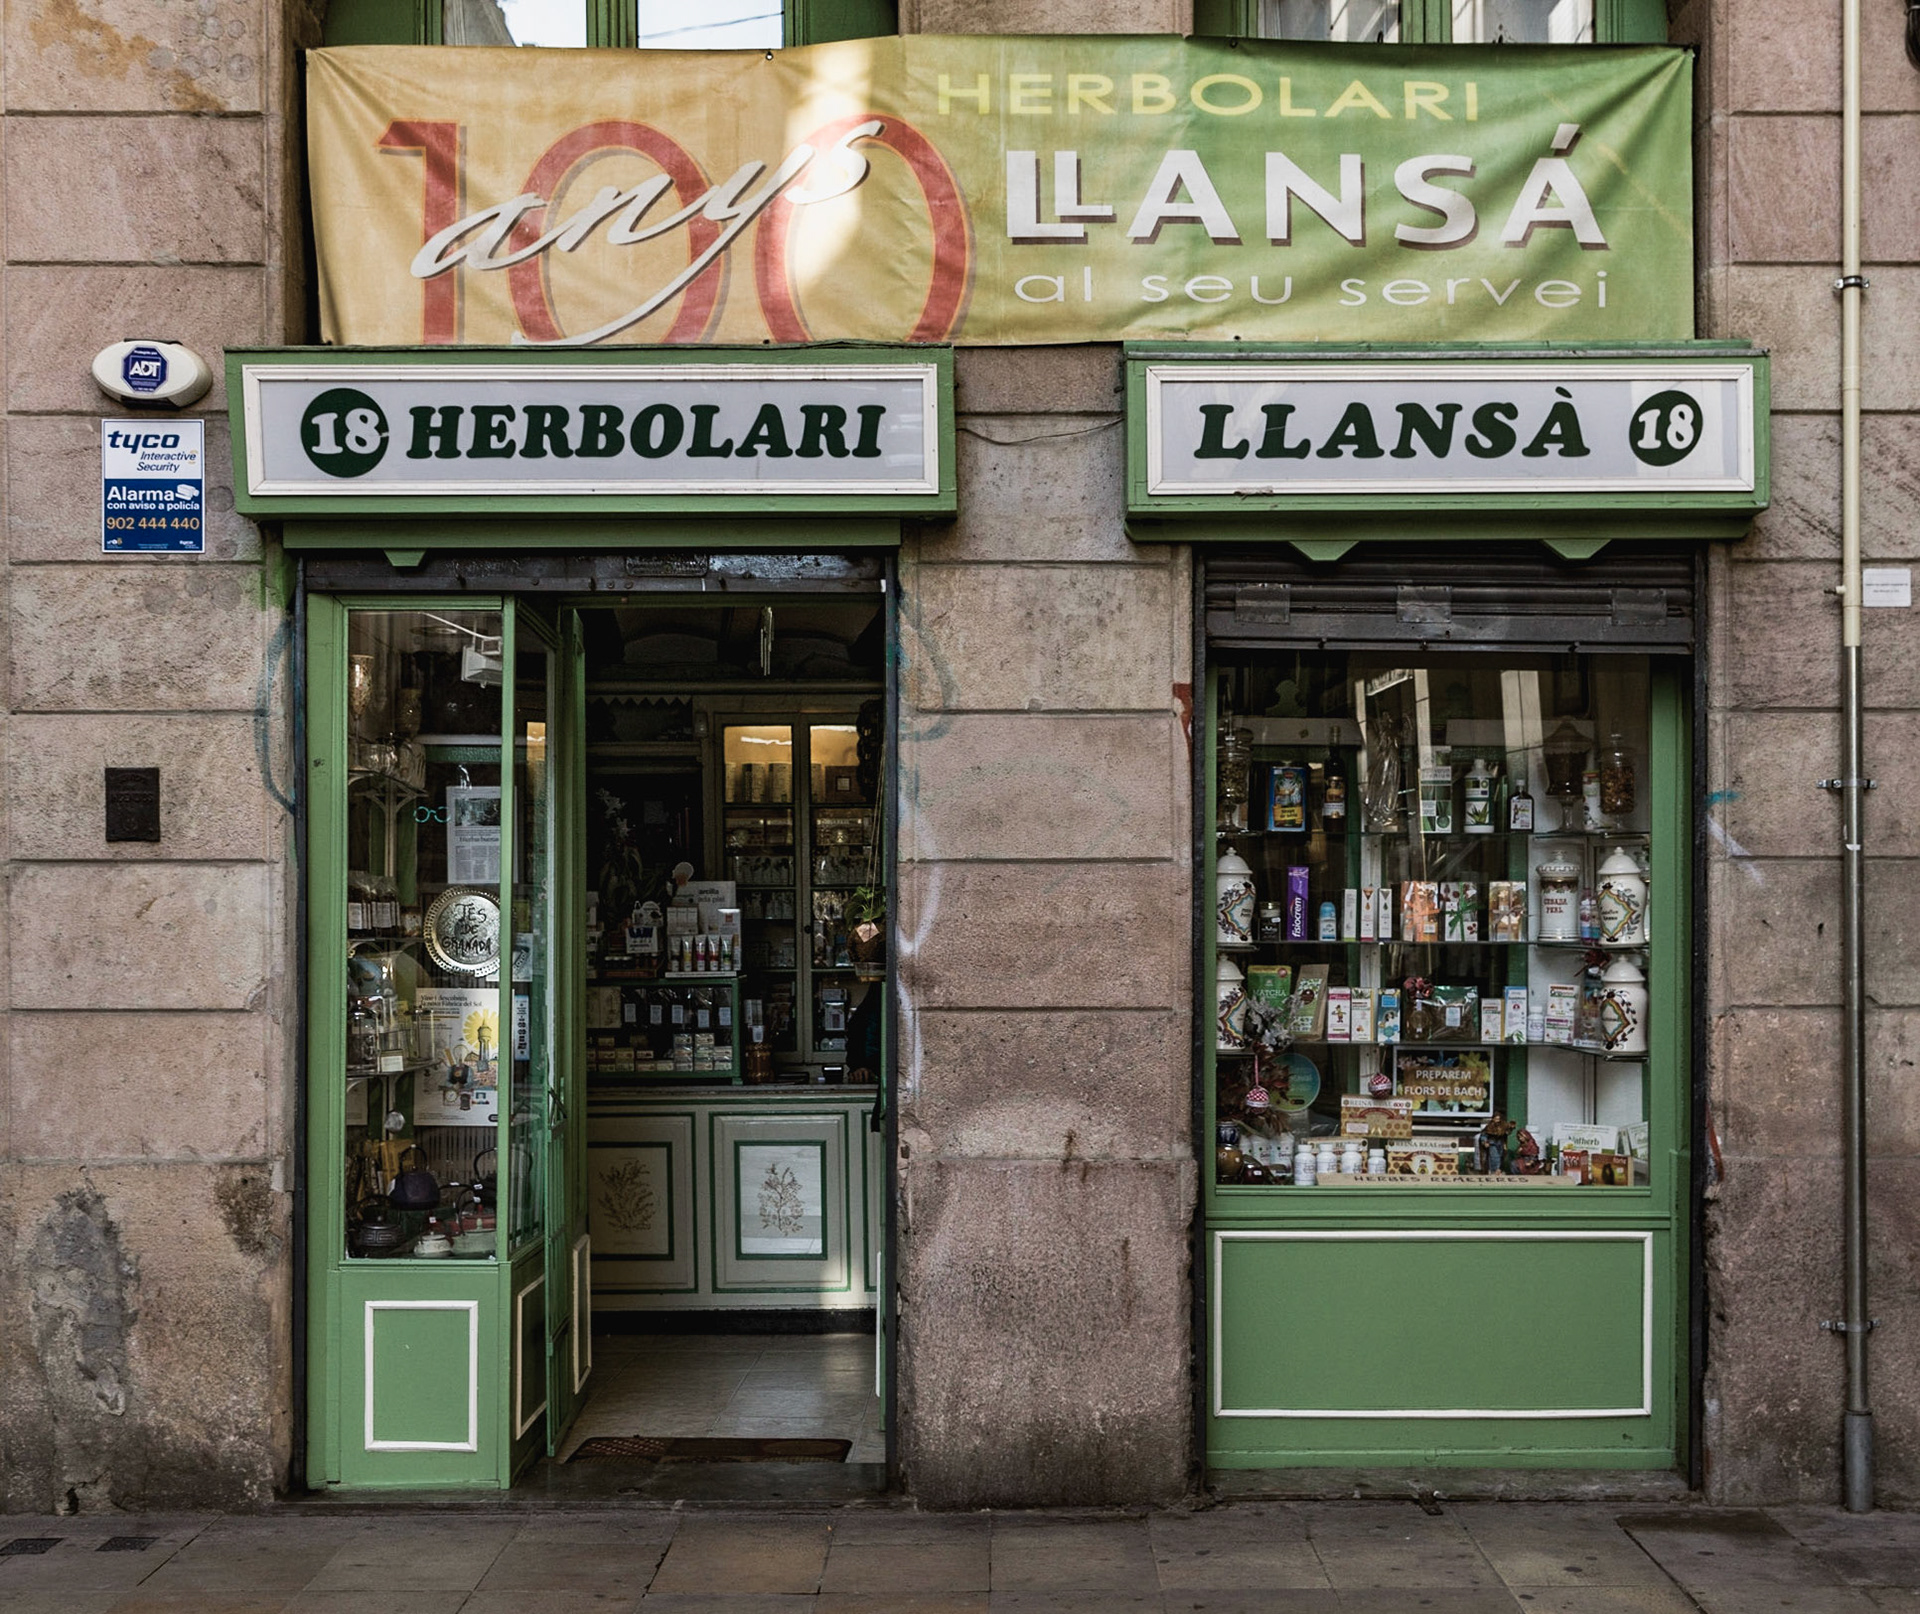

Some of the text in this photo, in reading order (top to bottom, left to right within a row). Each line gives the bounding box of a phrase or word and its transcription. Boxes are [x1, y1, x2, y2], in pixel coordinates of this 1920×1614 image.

[936, 73, 1478, 122] HERBOLARI
[1005, 123, 1610, 248] LLANSÁ
[373, 112, 974, 345] 100
[410, 119, 887, 345] anys
[1013, 266, 1610, 308] al seu servei
[130, 361, 161, 377] ADT
[310, 407, 385, 456] 18
[405, 403, 888, 459] HERBOLARI
[1193, 385, 1592, 459] LLANSÀ
[1636, 402, 1696, 451] 18
[107, 430, 180, 454] tyco
[137, 462, 180, 473] Security
[140, 451, 197, 461] Interactive
[107, 486, 174, 501] Alarma
[106, 501, 200, 512] con aviso a policía
[106, 517, 200, 530] 902 444 440
[455, 903, 487, 923] TES
[1291, 896, 1302, 938] fisiocrem
[1252, 988, 1287, 997] MATCHA
[1415, 1069, 1472, 1080] PREPAREM
[1404, 1086, 1482, 1097] FLORS DE BACH
